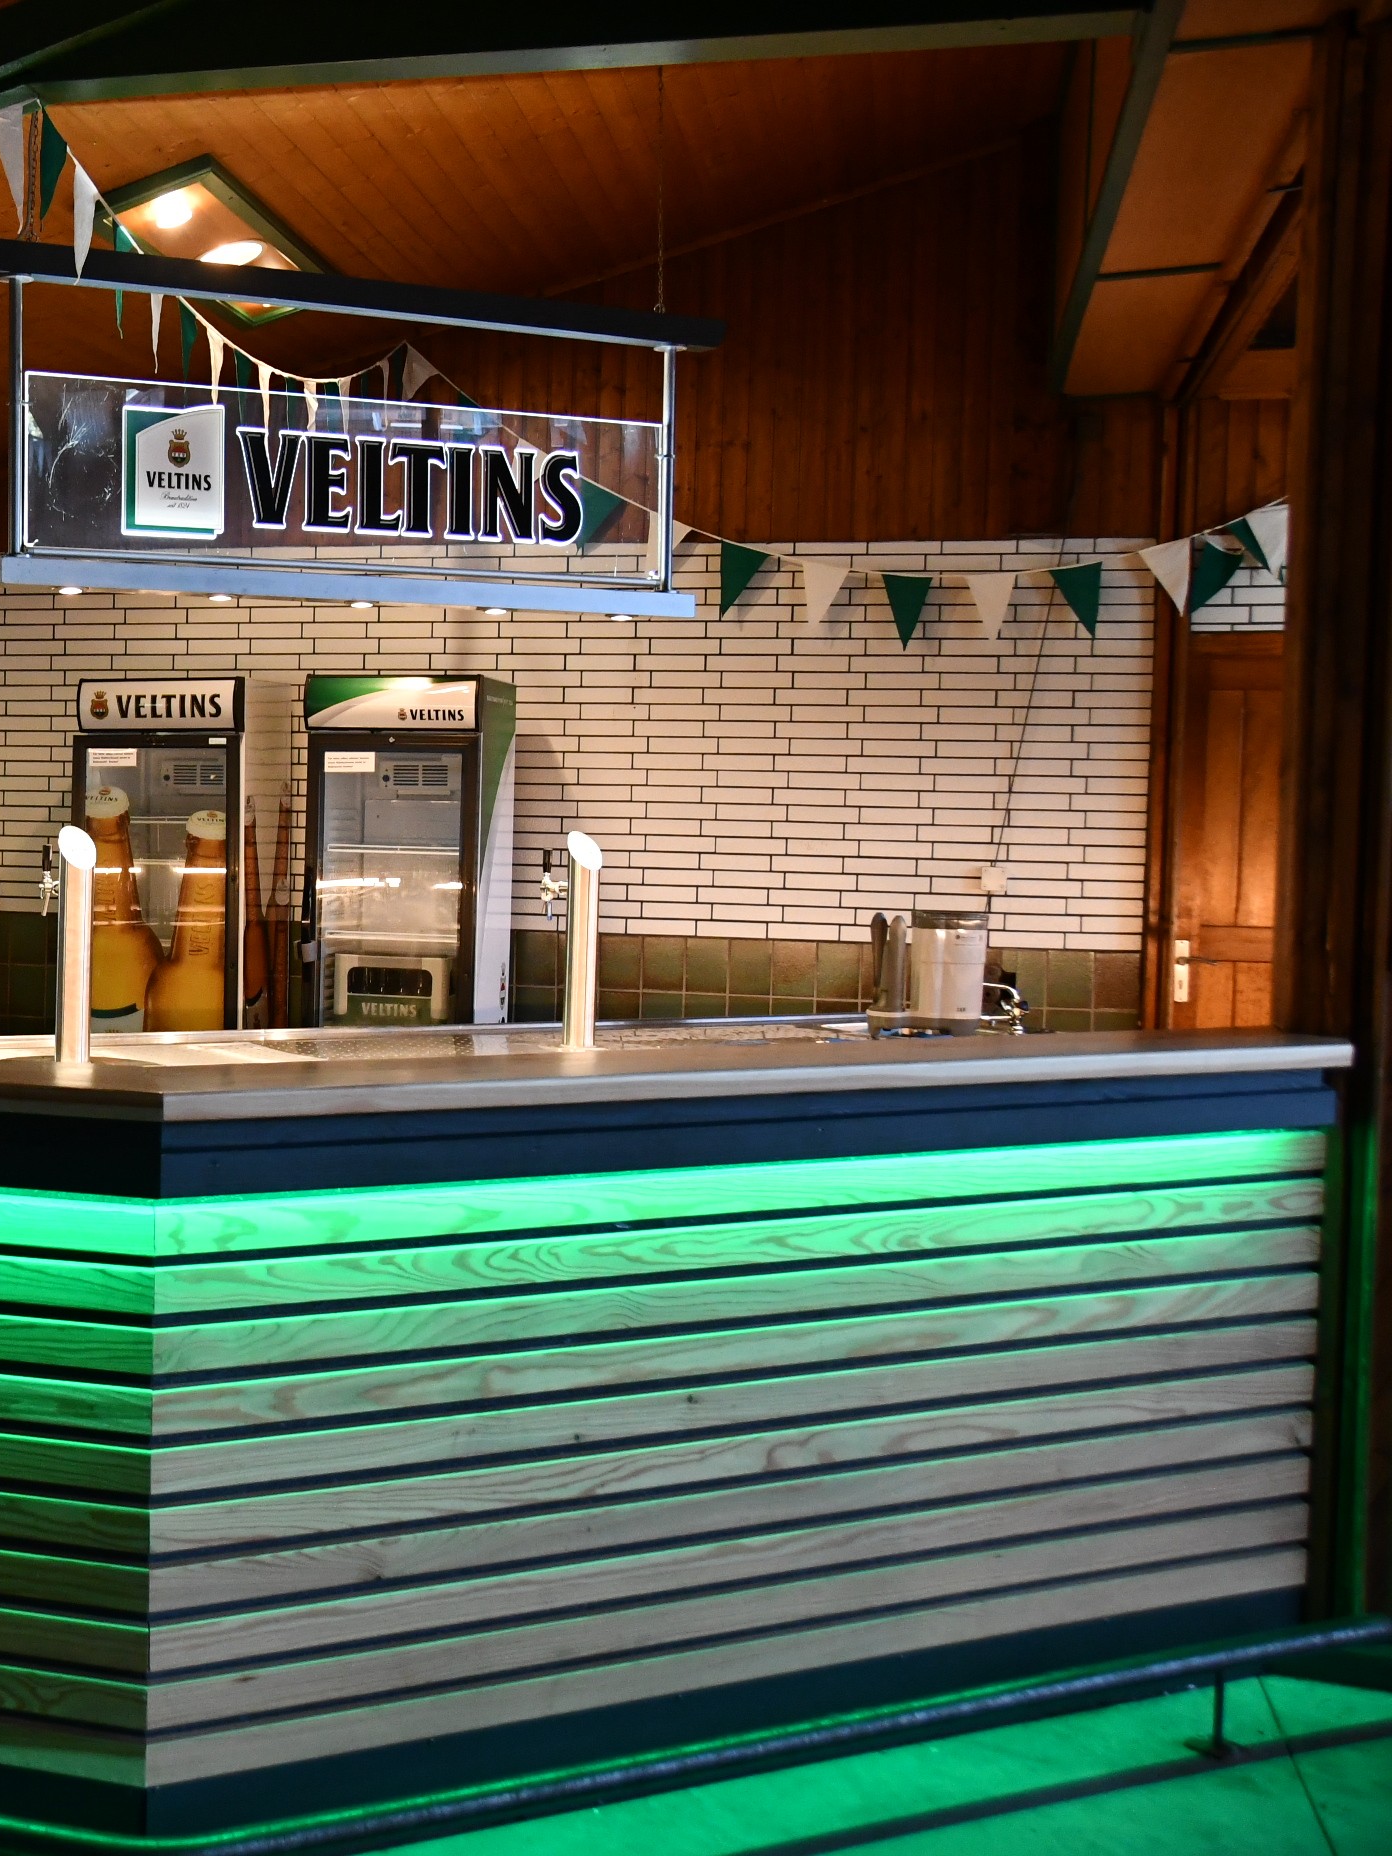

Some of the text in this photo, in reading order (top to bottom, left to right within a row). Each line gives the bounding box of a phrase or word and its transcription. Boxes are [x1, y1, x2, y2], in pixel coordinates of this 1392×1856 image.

[146, 470, 212, 491] VELTINS
[237, 426, 583, 547] VELTINS
[115, 693, 222, 719] VELTINS
[409, 708, 465, 721] VELTINS
[361, 1002, 417, 1018] VELTINS
